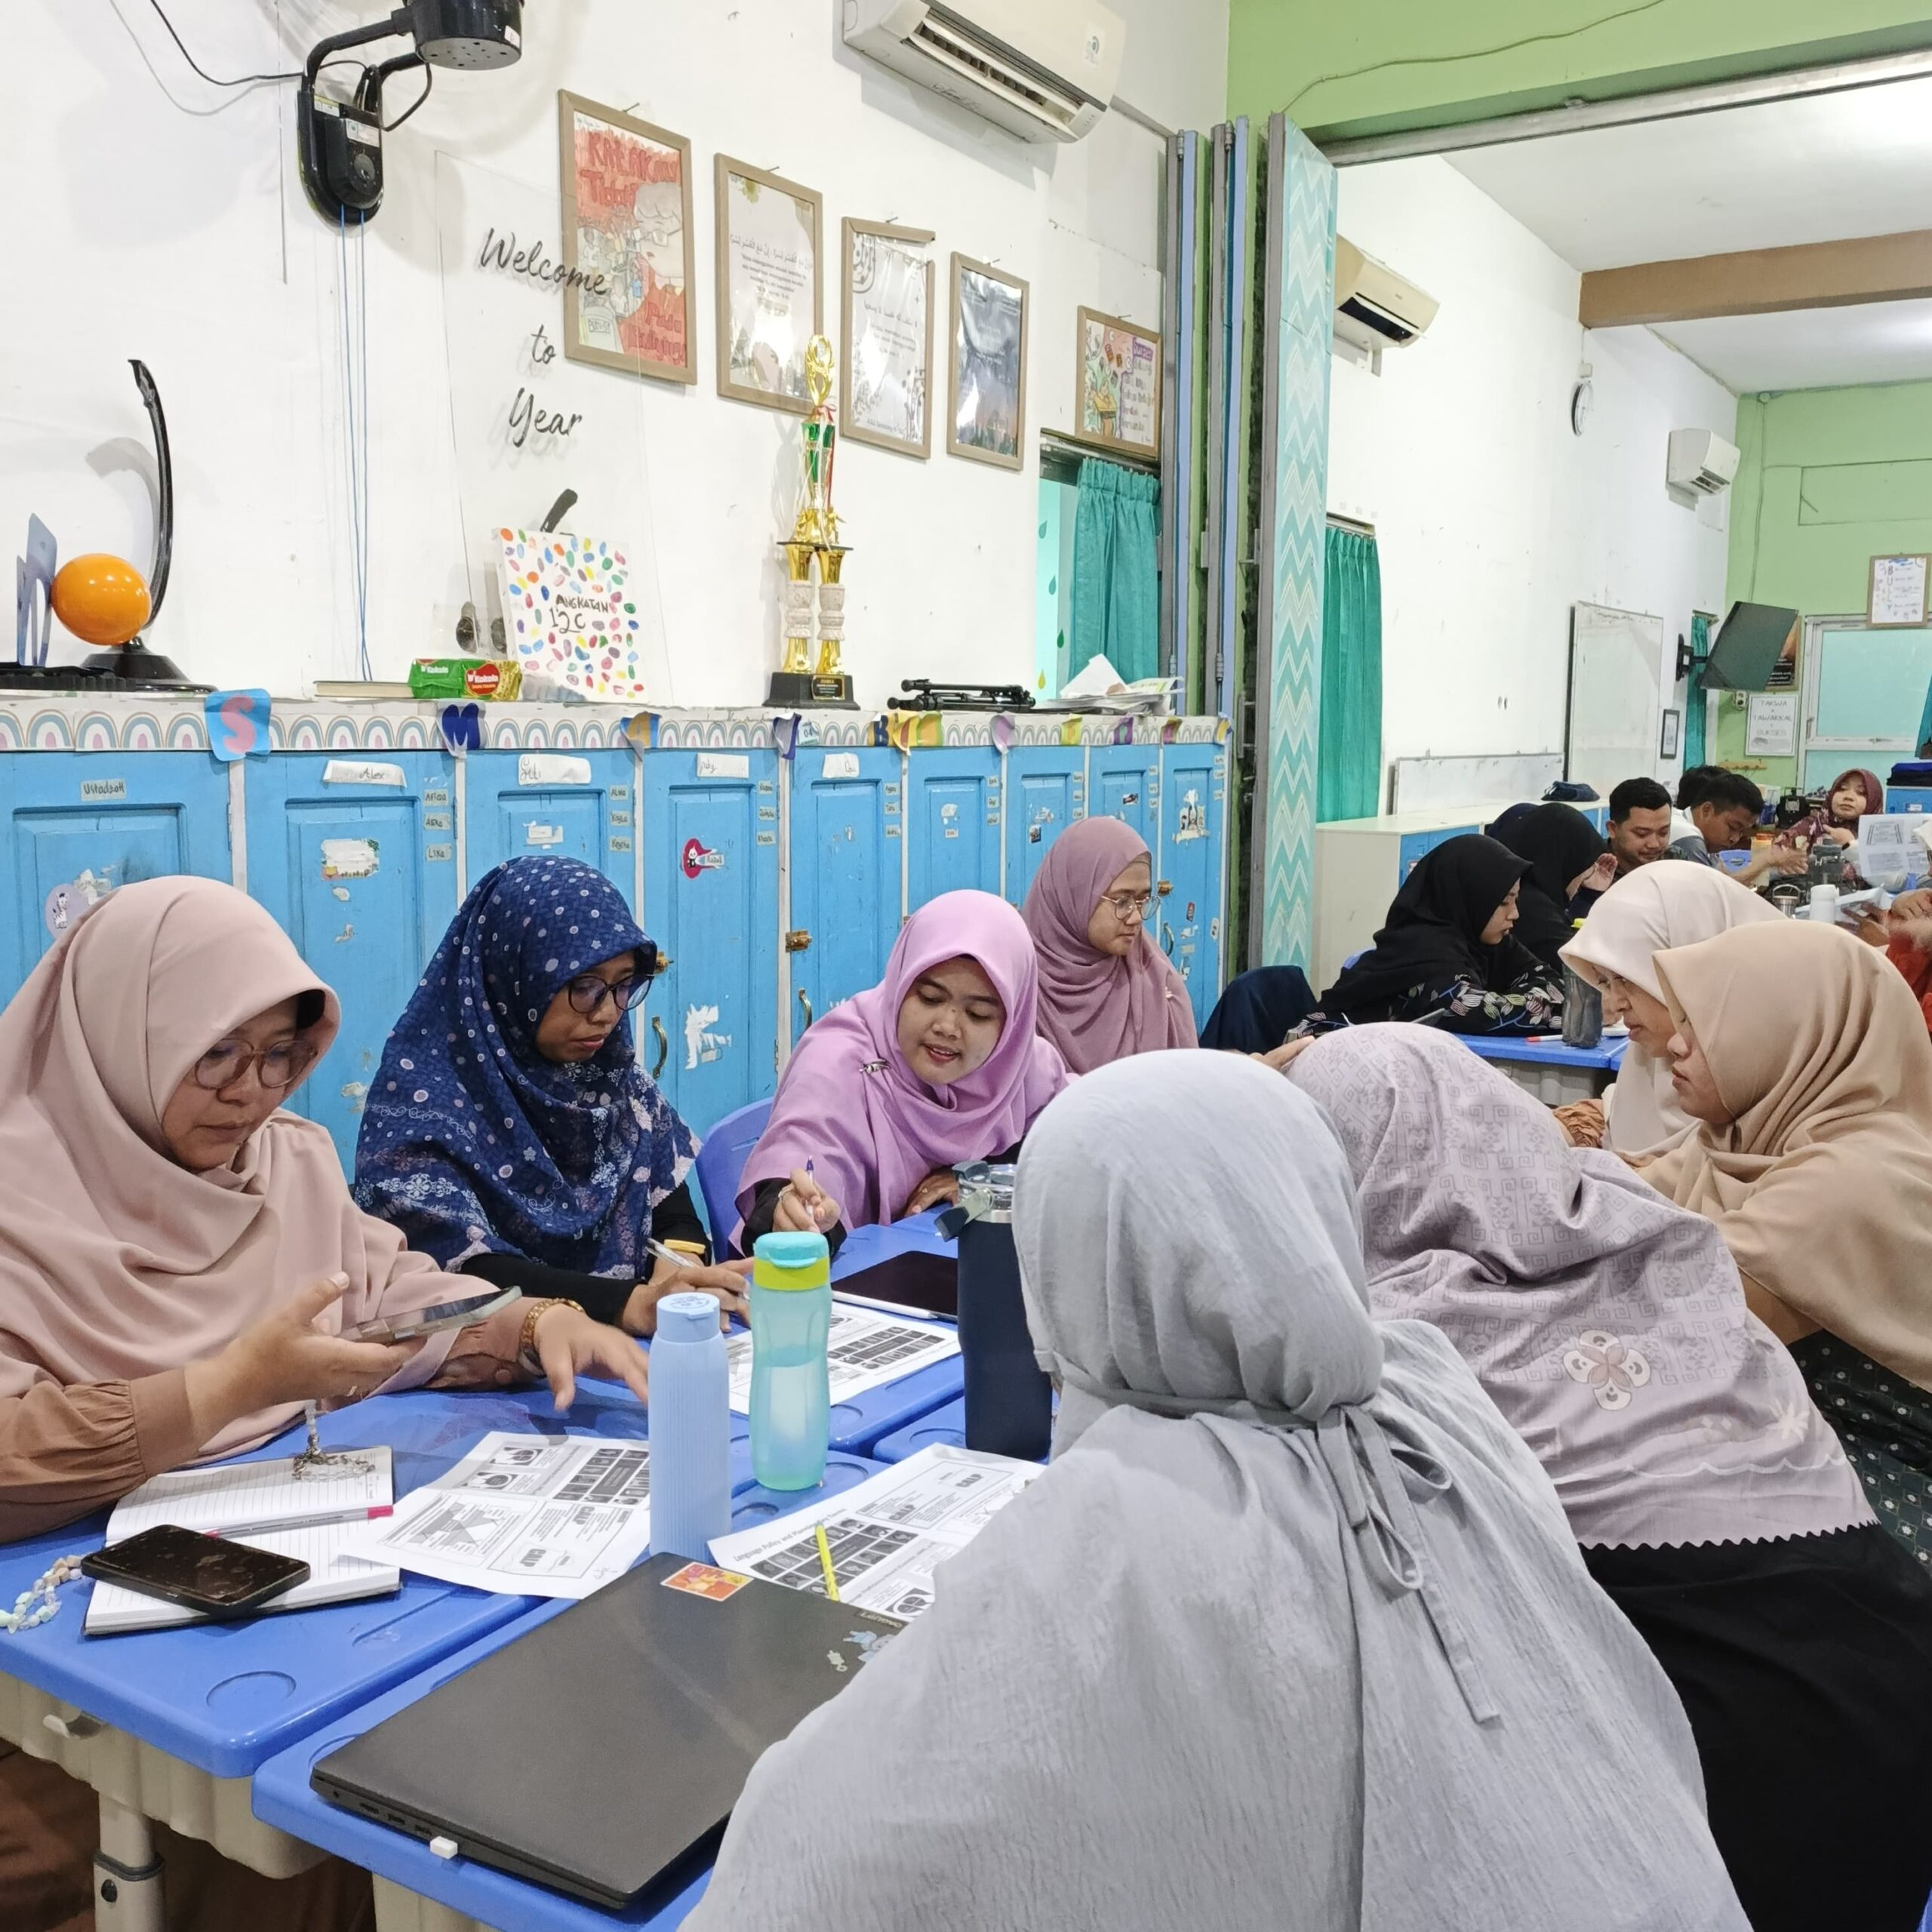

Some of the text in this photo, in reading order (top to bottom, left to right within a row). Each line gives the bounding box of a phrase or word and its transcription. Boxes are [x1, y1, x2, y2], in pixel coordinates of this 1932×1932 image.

[480, 227, 608, 295] Welcome
[531, 324, 556, 364] to
[509, 387, 583, 448] Year
[555, 593, 609, 614] ANGKATAN
[358, 766, 385, 780] Alex
[519, 1548, 547, 1567] CALP
[860, 1611, 903, 1629] Lenovo
